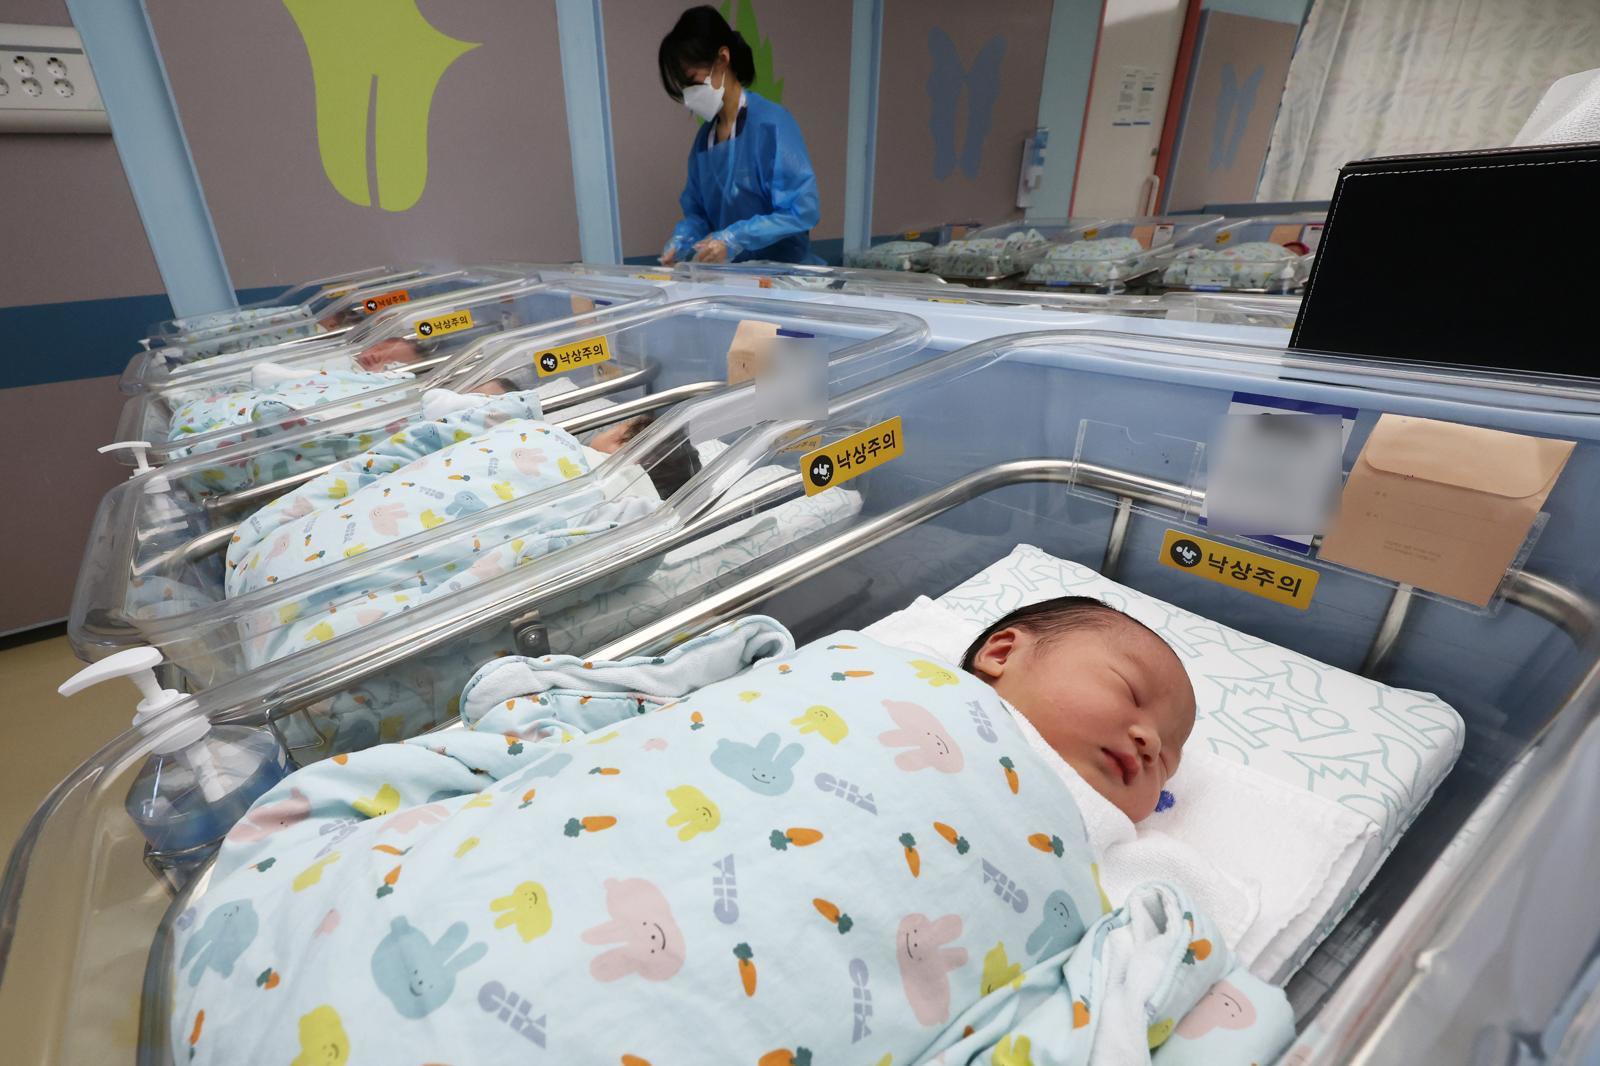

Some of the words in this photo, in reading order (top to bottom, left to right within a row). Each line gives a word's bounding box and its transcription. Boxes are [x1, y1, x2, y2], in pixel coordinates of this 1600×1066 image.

[433, 315, 469, 330] 낙상주의
[560, 343, 604, 364] 낙상주의
[836, 430, 896, 469] 낙상주의
[1208, 553, 1302, 597] 낙상주의
[814, 772, 878, 816] CHA
[712, 853, 740, 925] CHA
[982, 857, 1029, 914] CHA
[478, 980, 547, 1050] CHA
[848, 958, 873, 1045] CHA
